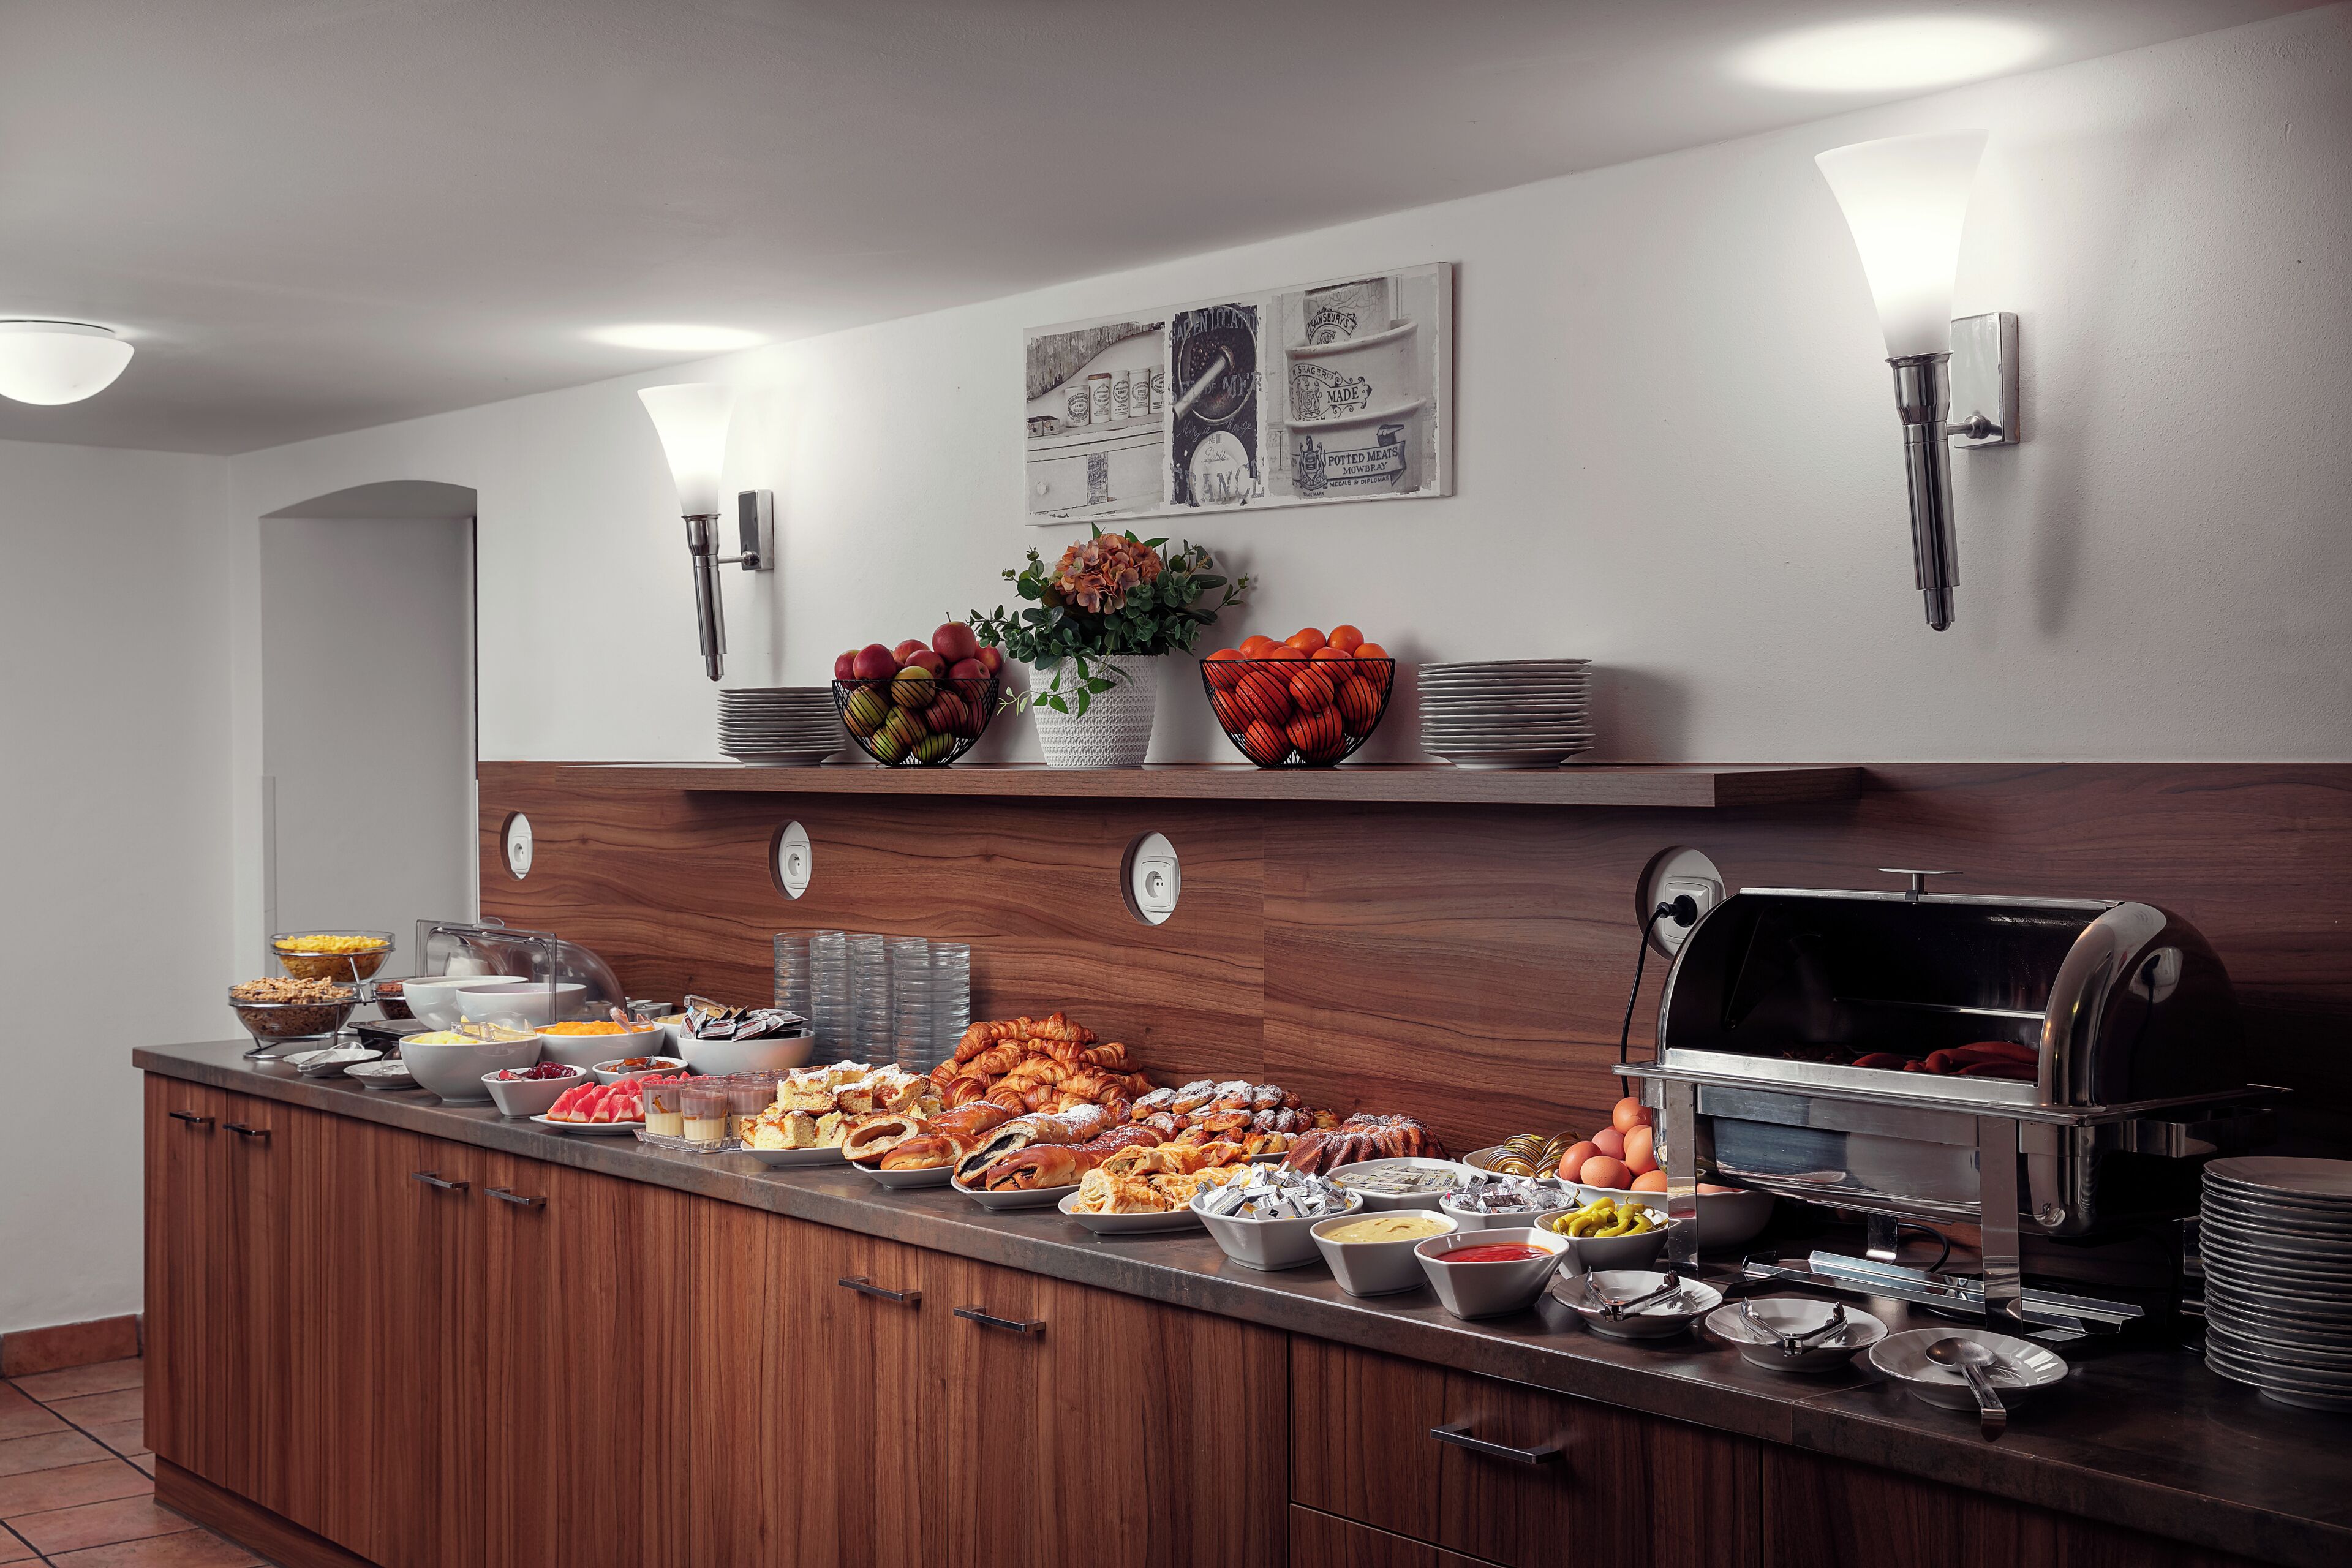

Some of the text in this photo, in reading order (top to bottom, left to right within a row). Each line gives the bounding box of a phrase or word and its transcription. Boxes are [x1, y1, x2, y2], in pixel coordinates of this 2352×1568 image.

[1327, 386, 1359, 403] MADE
[1328, 446, 1399, 467] POTTED MEATS
[1343, 461, 1388, 475] MOWBRAY
[1329, 479, 1351, 488] MEDALS
[1360, 475, 1389, 484] DIPLOMAS
